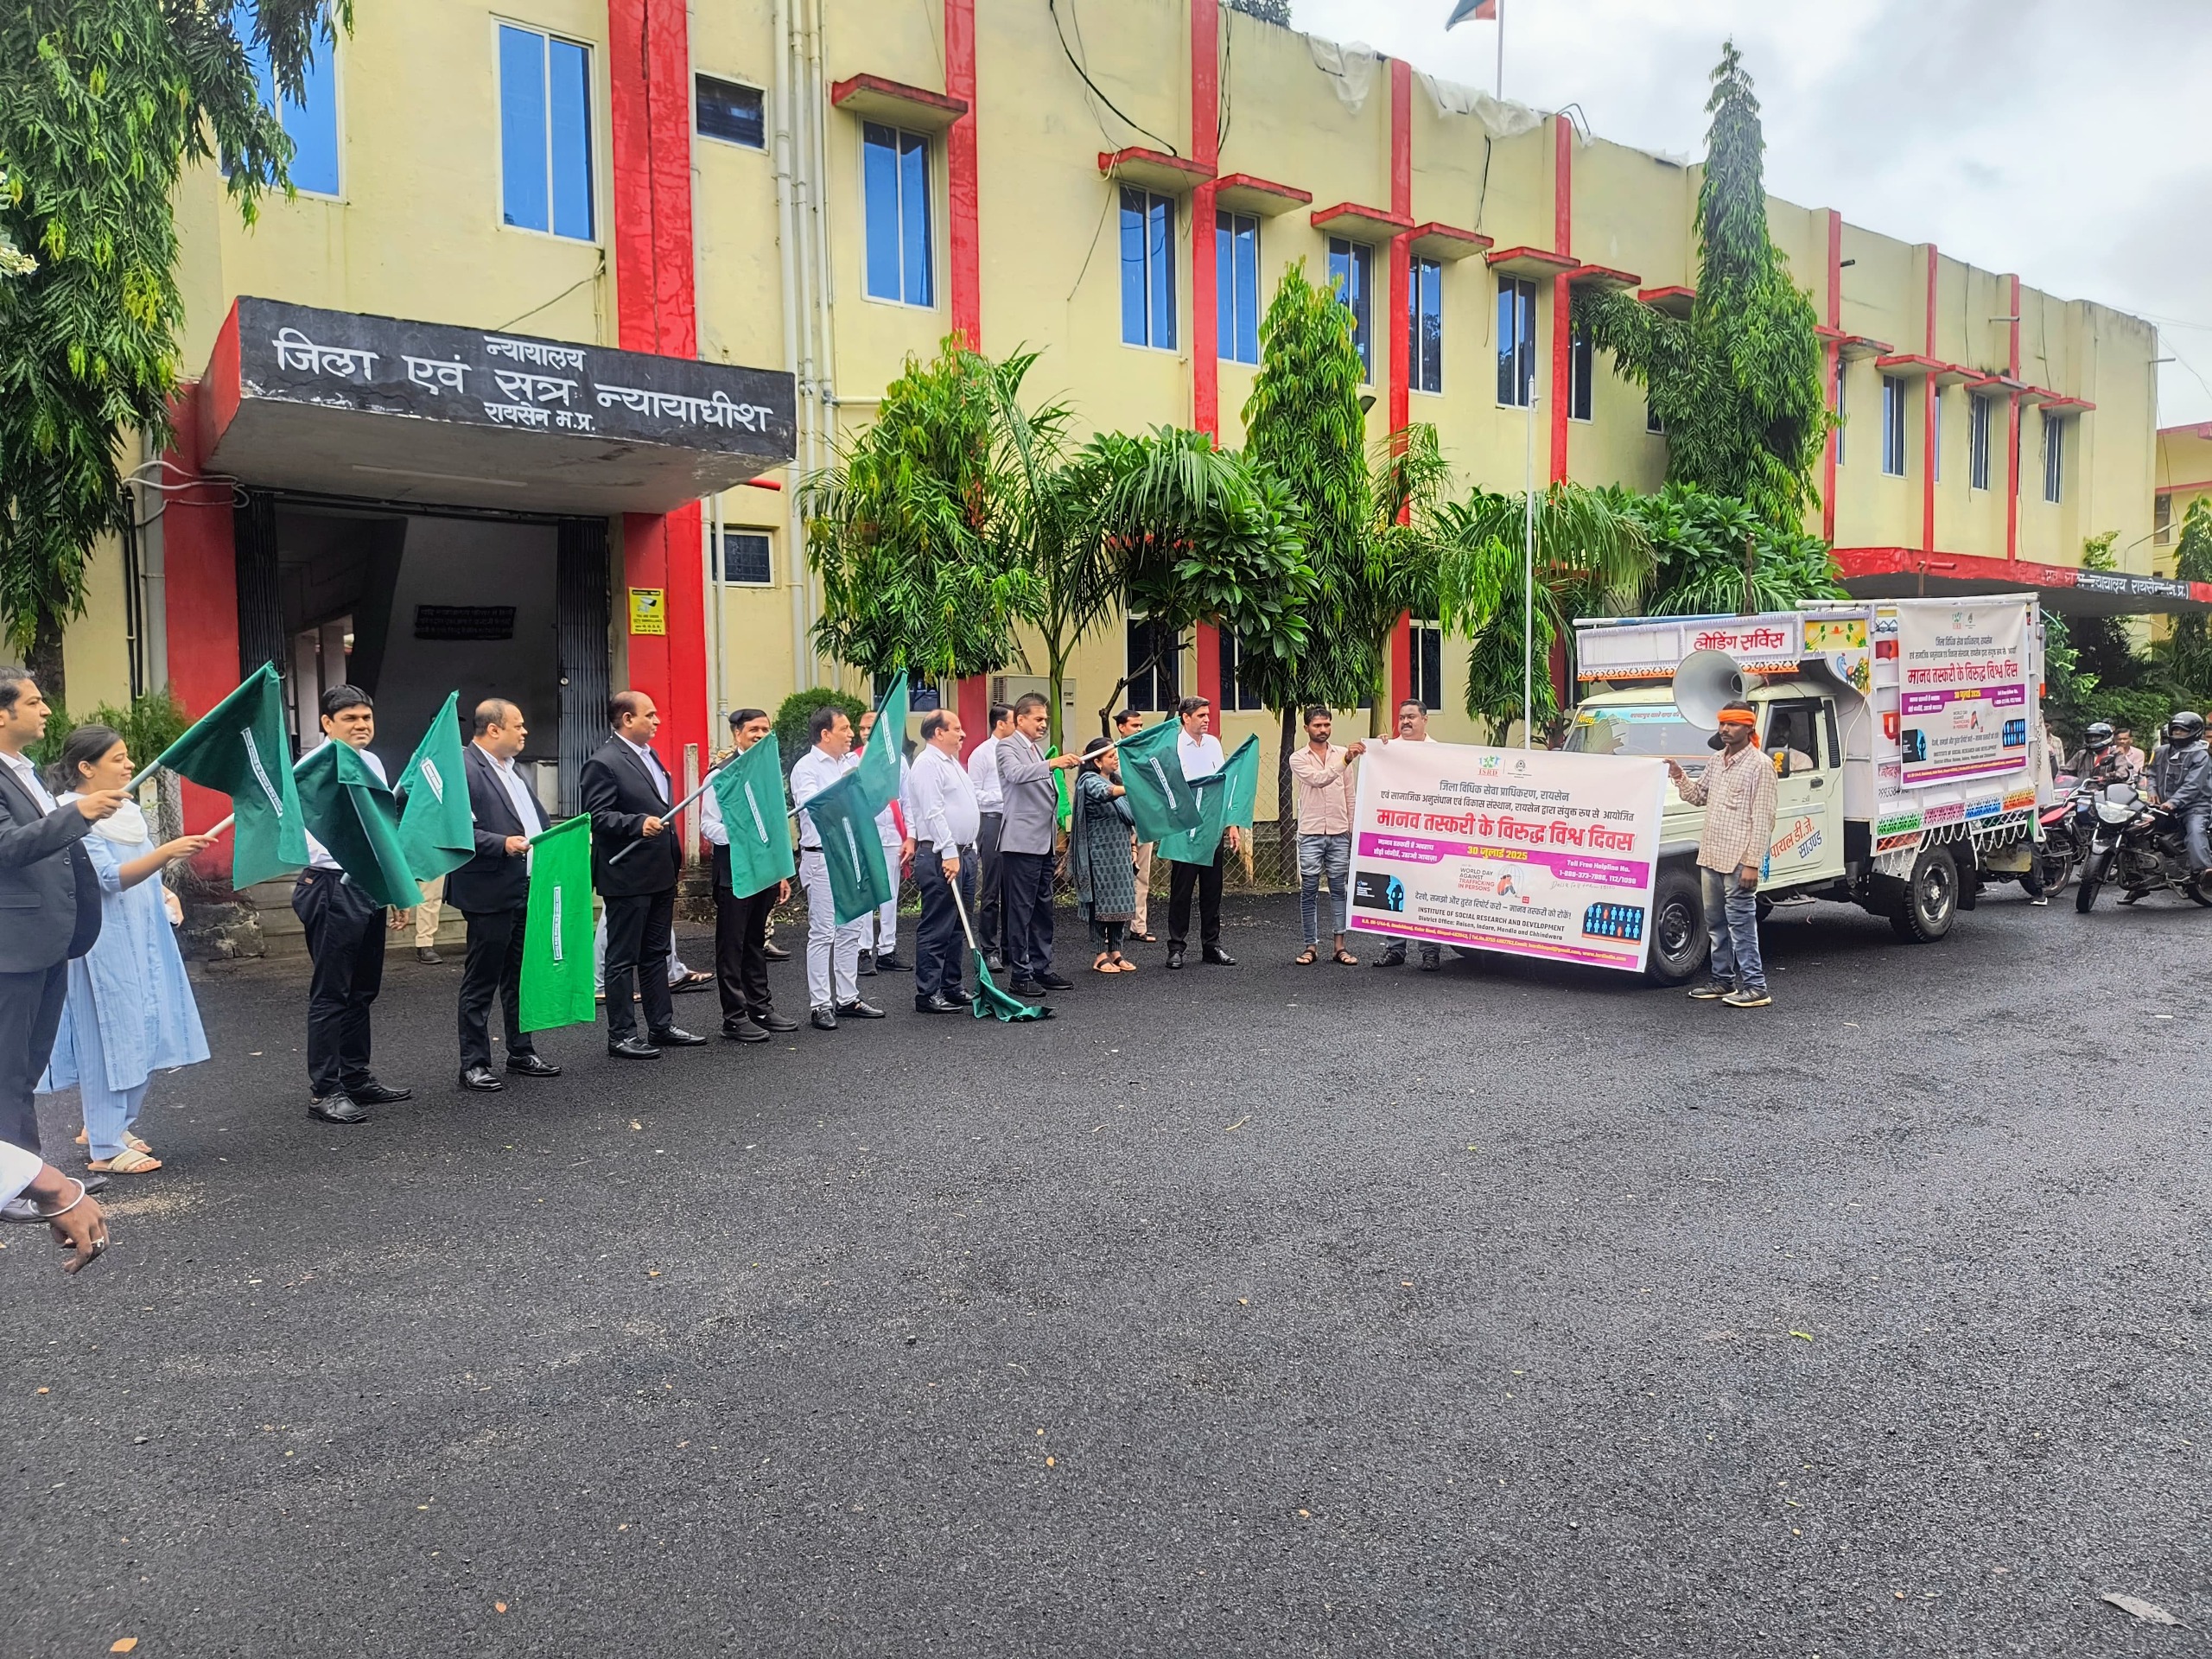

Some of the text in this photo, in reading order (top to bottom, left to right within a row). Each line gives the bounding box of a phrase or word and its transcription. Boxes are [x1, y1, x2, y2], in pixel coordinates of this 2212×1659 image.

[484, 335, 587, 372] न्यायालय
[272, 327, 773, 433] जिला एवं सत्र न्यायाधीश
[484, 401, 551, 427] रायसेन
[1694, 628, 1785, 651] लोडिंग सर्विस
[1907, 668, 1931, 684] मानव
[1932, 663, 1955, 683] तस्करी
[1956, 663, 1964, 682] के
[1440, 780, 1457, 792] जिला
[1460, 781, 1482, 794] विधिक
[1484, 784, 1498, 796] सेवा
[1541, 789, 1569, 801] रायसेन
[1381, 790, 1389, 799] एवं
[1391, 791, 1421, 801] सामाजिक
[1422, 793, 1452, 805] अनुसंधान
[1453, 796, 1462, 806] एवं
[1464, 797, 1484, 808] विकास
[1515, 802, 1540, 813] रायसेन
[1541, 805, 1555, 815] द्वारा
[1592, 808, 1599, 818] से
[1603, 810, 1635, 821] आयोजित
[1376, 809, 1635, 851] मानव तस्करी के विरुद्ध विश्व दिवस
[1467, 846, 1528, 860] 30 जुलाई 2025
[1770, 833, 1794, 858] पायल
[1459, 878, 1495, 887] TRAFFICKING
[1418, 906, 1446, 916] INSTITUTE
[1454, 911, 1476, 920] SOCIAL
[1476, 914, 1507, 925] RESEARCH
[1522, 920, 1565, 932] DEVELOPMENT
[1418, 915, 1437, 924] District
